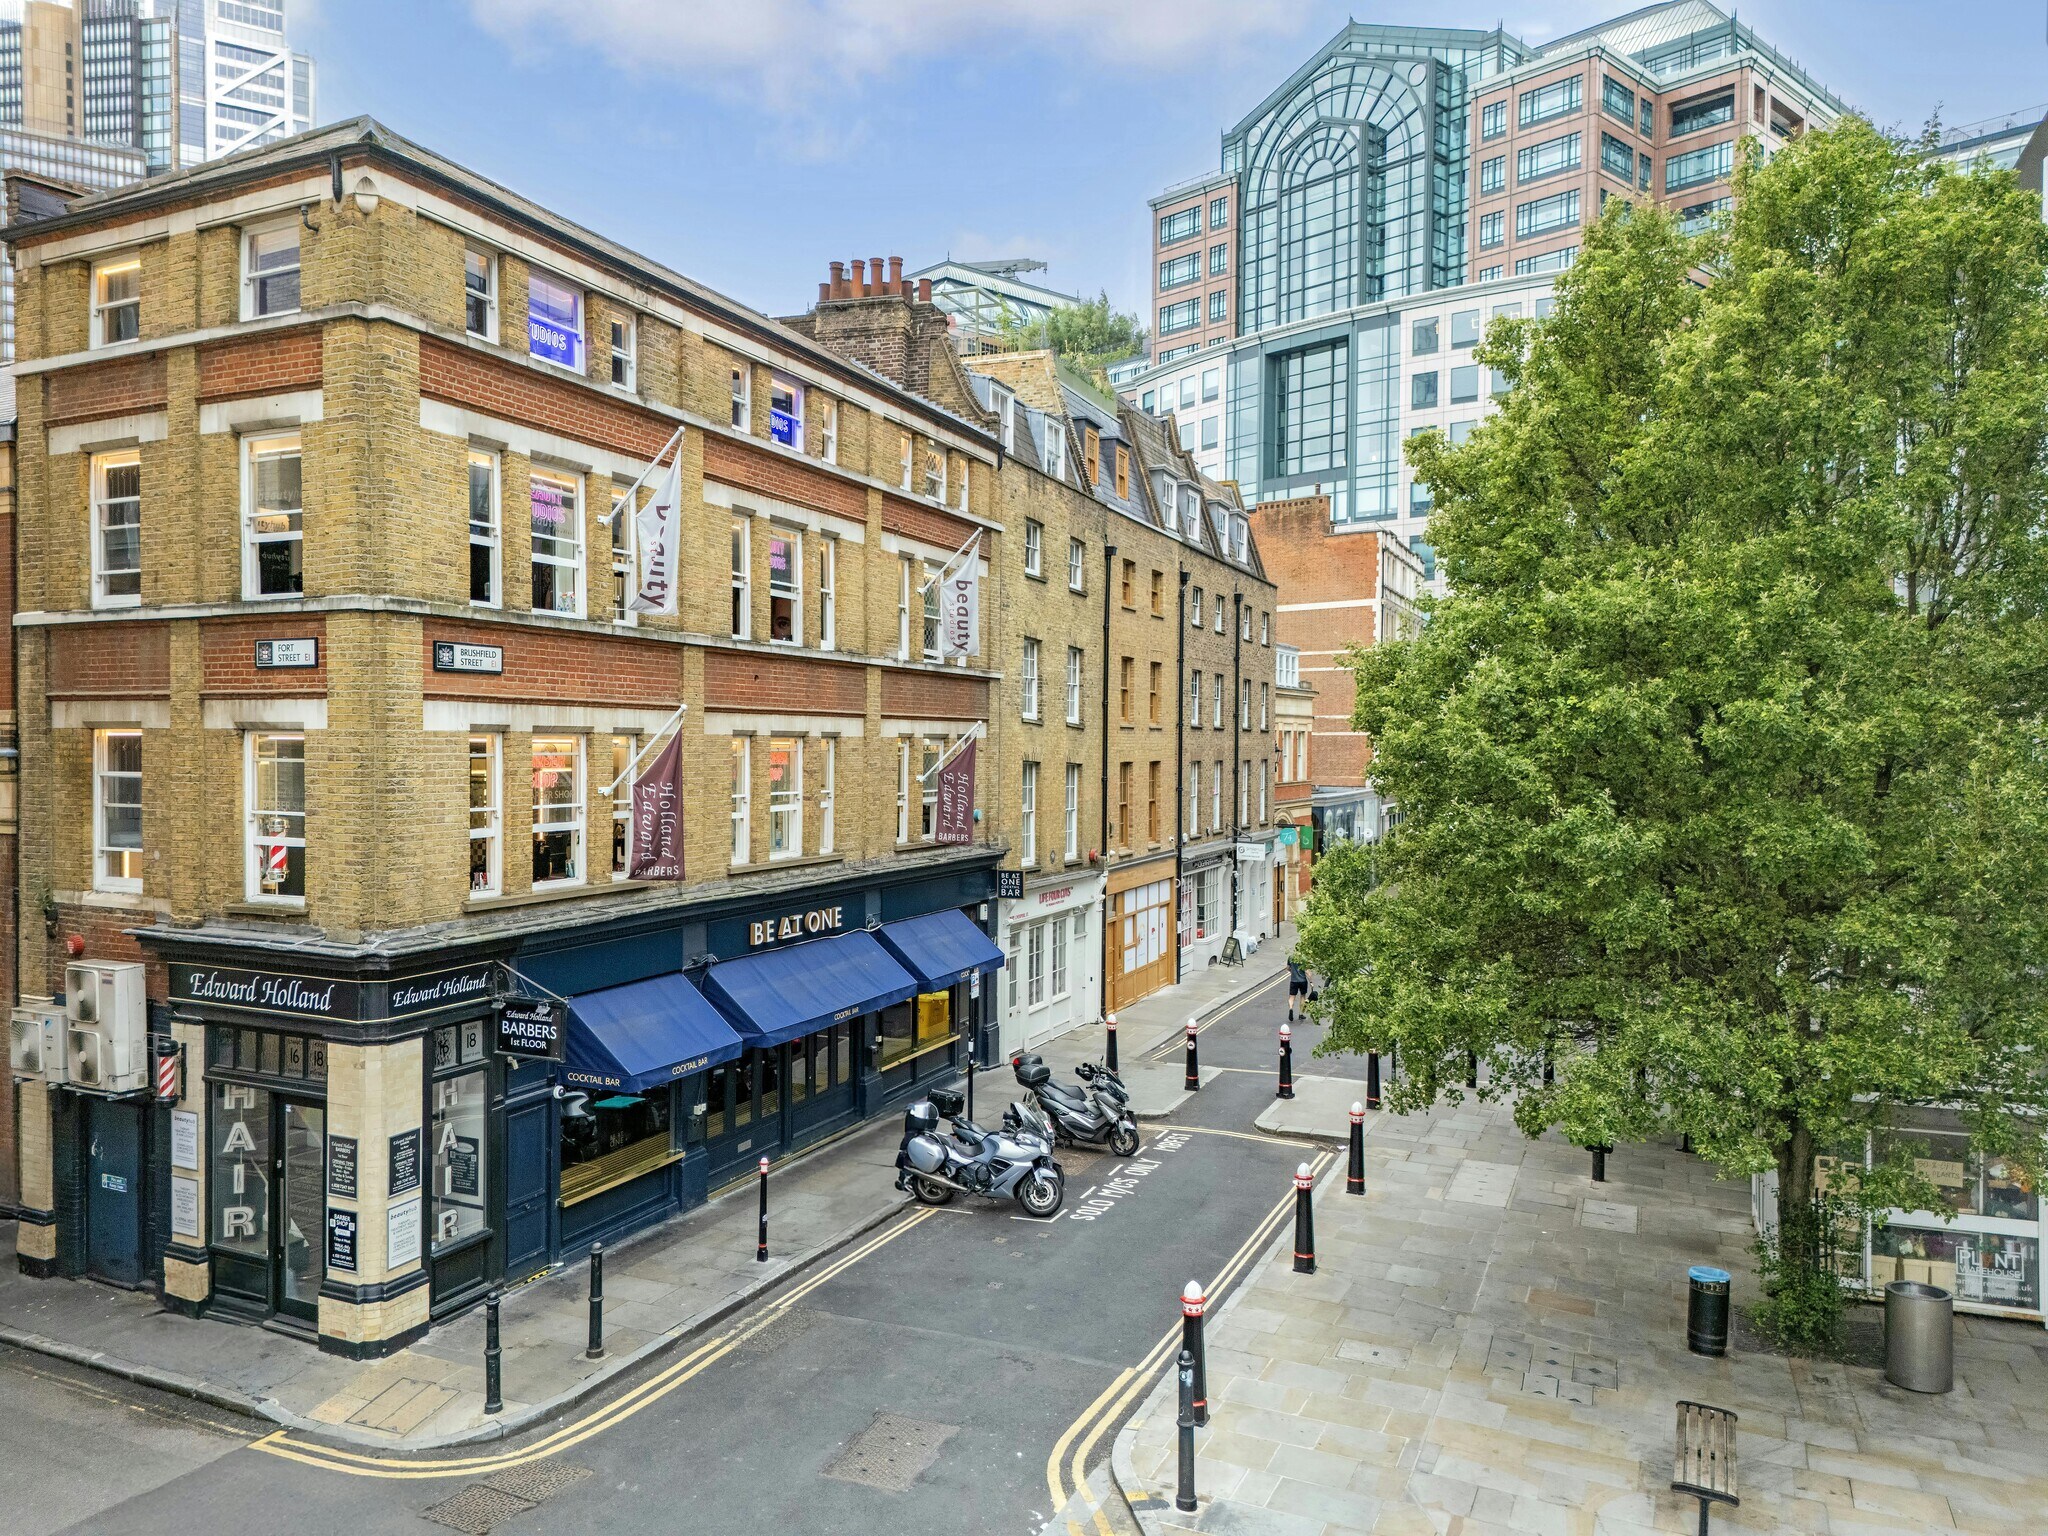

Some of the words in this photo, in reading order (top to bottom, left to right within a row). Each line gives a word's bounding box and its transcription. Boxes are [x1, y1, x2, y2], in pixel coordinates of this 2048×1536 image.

[530, 322, 566, 351] UDIOS
[953, 579, 972, 652] beauty
[278, 644, 294, 652] FORT
[460, 648, 497, 659] BRUSHFIELD
[278, 654, 300, 662] STREET
[460, 658, 483, 667] STREET
[943, 772, 956, 830] Edward
[957, 772, 969, 830] Holland
[641, 783, 657, 862] Edward
[659, 781, 676, 860] Holland
[938, 832, 969, 842] BARBERS
[1001, 878, 1020, 886] ONE
[750, 919, 775, 945] BE
[778, 914, 803, 939] AT
[804, 906, 842, 934] ONE
[190, 971, 260, 1002] Edward
[260, 978, 335, 1011] Holland
[393, 980, 442, 1008] Edward
[442, 971, 488, 997] Holland
[506, 1010, 529, 1020] Edward
[529, 1011, 554, 1023] Holland
[834, 1010, 851, 1021] COCKTAIL
[851, 1006, 859, 1015] BAR
[501, 1020, 557, 1040] BARBERS
[466, 1032, 477, 1048] 18
[510, 1037, 520, 1047] 1st
[521, 1038, 547, 1050] FLOOR
[290, 1048, 300, 1064] 16
[313, 1050, 324, 1067] 18
[671, 1061, 697, 1075] COCKTAIL
[697, 1056, 708, 1067] BAR
[567, 1072, 603, 1085] COCKTAIL
[604, 1077, 620, 1087] BAR
[1069, 1199, 1115, 1221] SOLO
[1097, 1177, 1139, 1198] M/CS
[1123, 1157, 1162, 1176] ONLY
[333, 1213, 351, 1222] BARBER
[390, 1205, 417, 1220] beautyhub
[336, 1219, 349, 1227] SHOP
[1959, 1249, 2020, 1269] PLNT
[1959, 1264, 2021, 1279] WAREHOUSE
